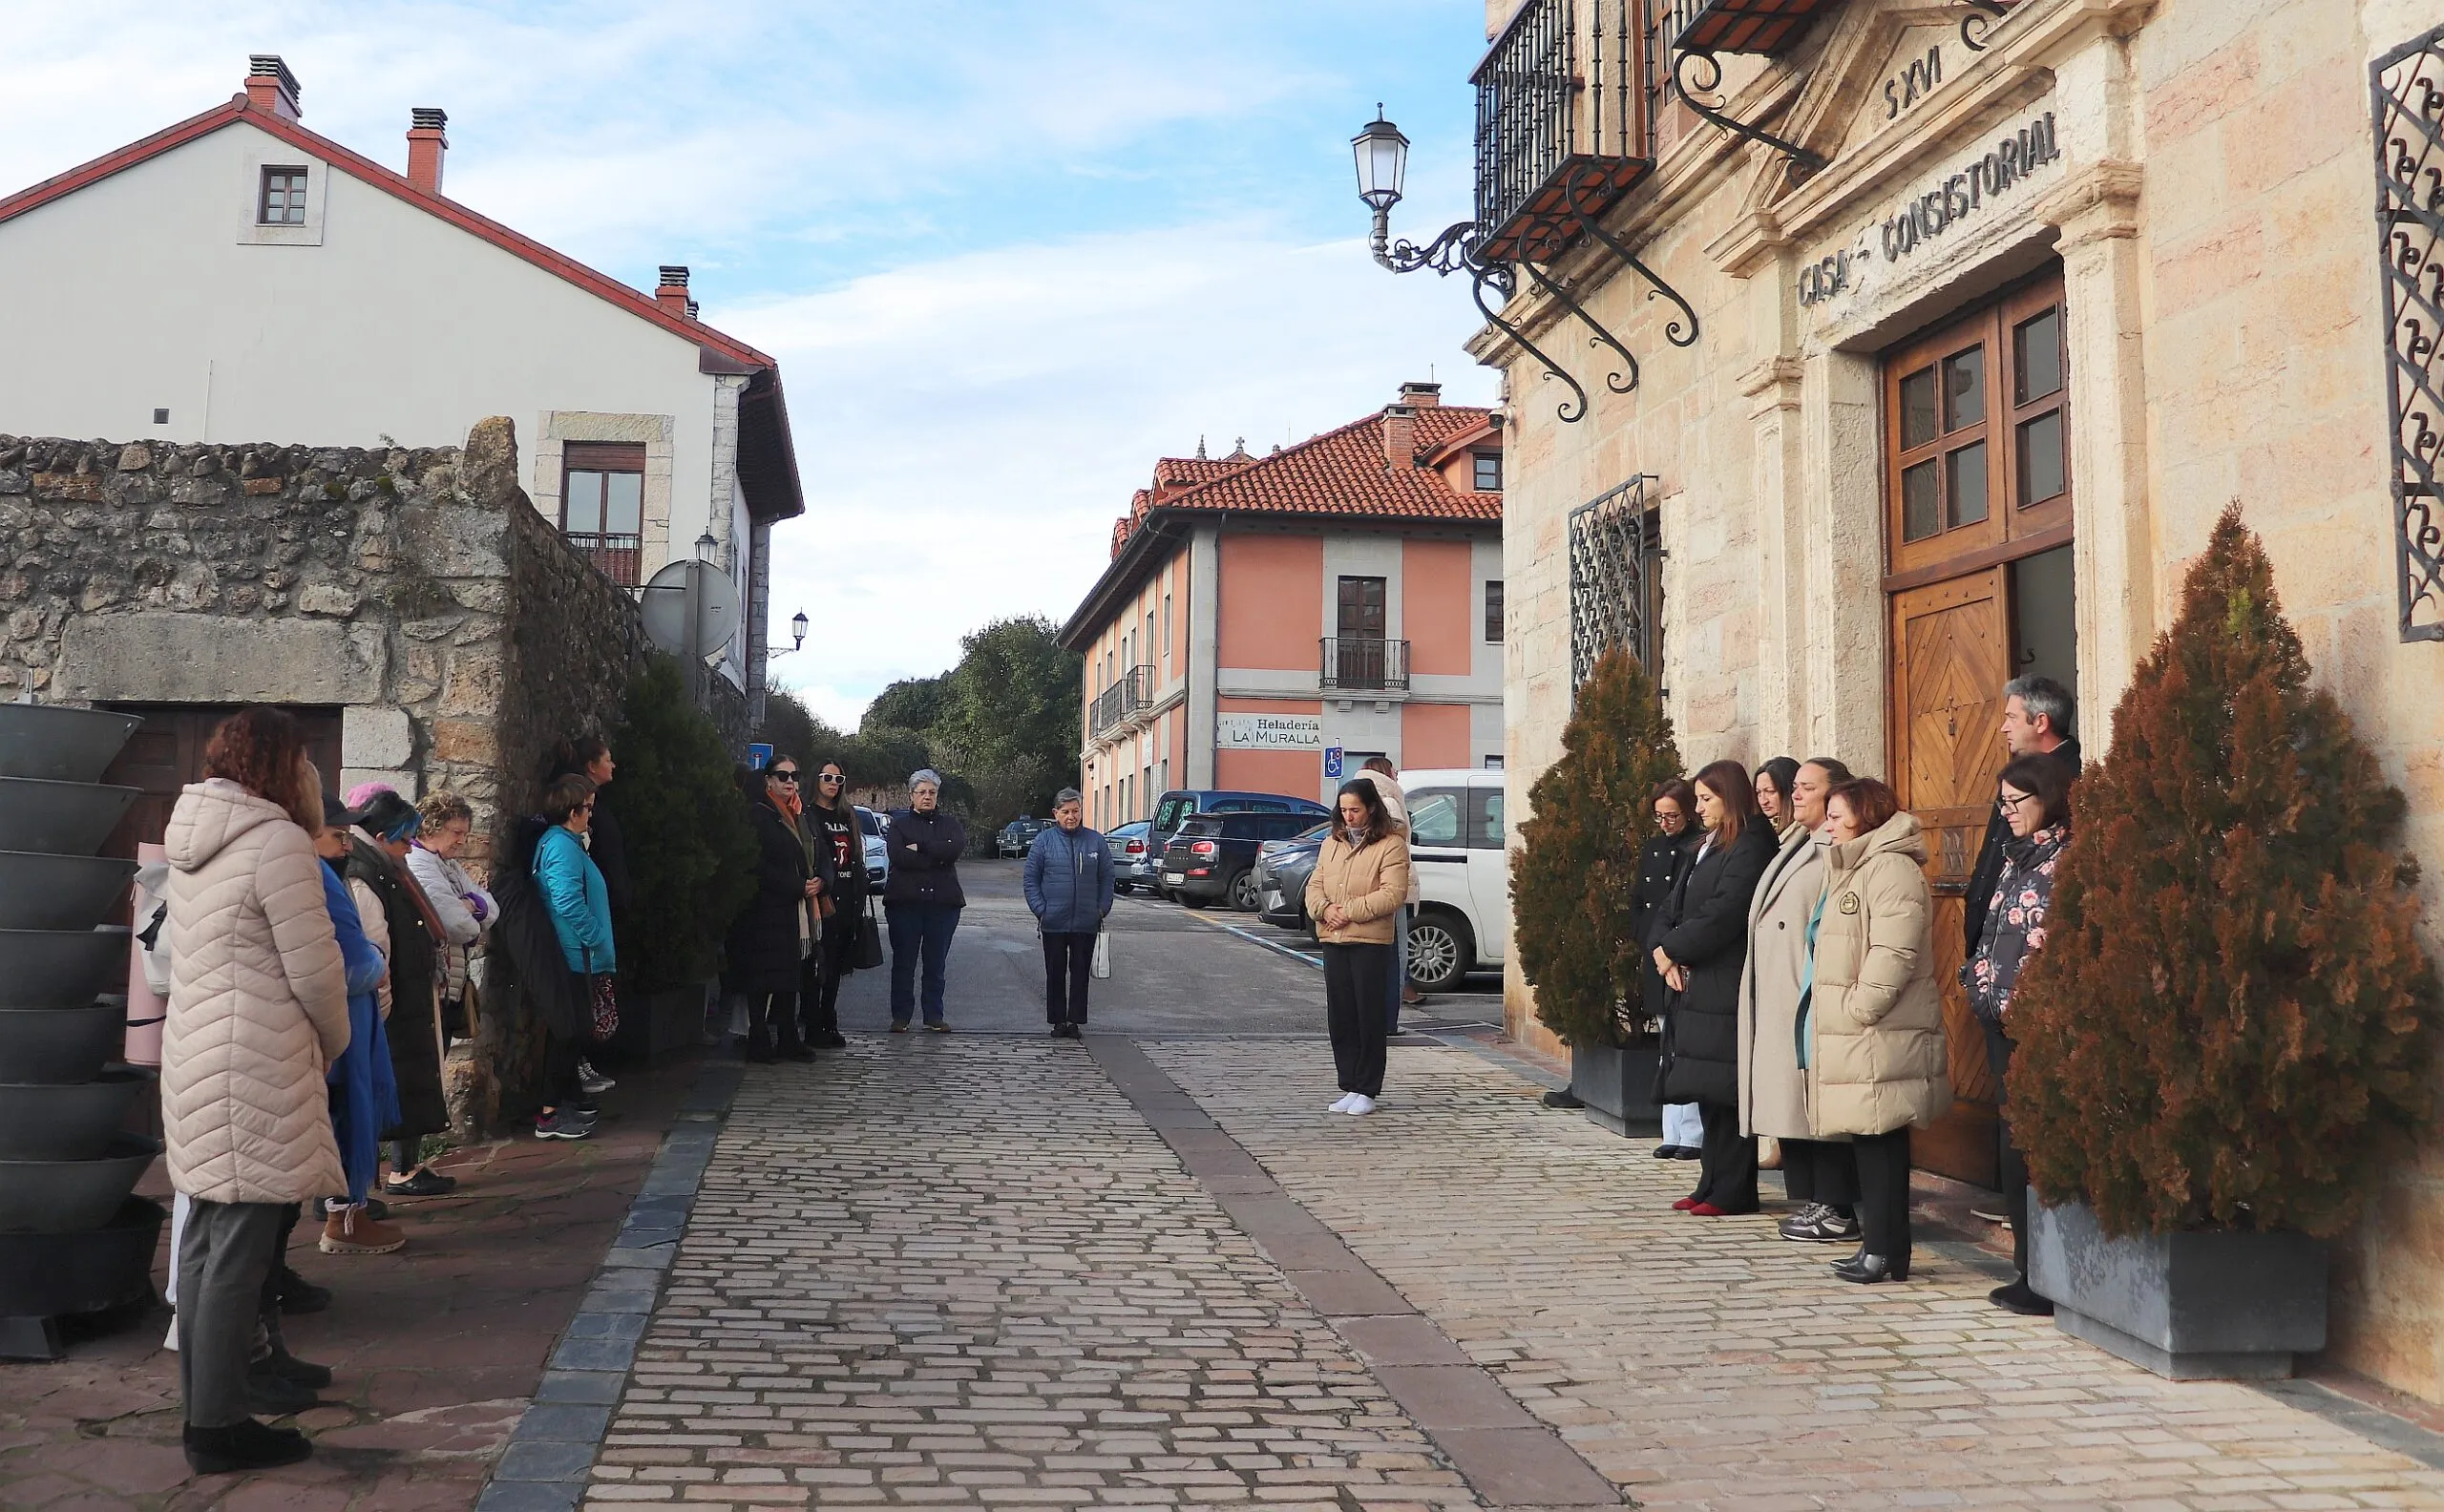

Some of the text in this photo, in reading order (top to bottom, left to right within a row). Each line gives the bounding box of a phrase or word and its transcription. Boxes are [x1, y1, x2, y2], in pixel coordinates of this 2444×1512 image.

[1798, 249, 1849, 307] CASA
[1881, 112, 2061, 262] CONSISTORIAL
[1257, 719, 1320, 730] Heladería
[1233, 729, 1321, 745] LA MURALLA
